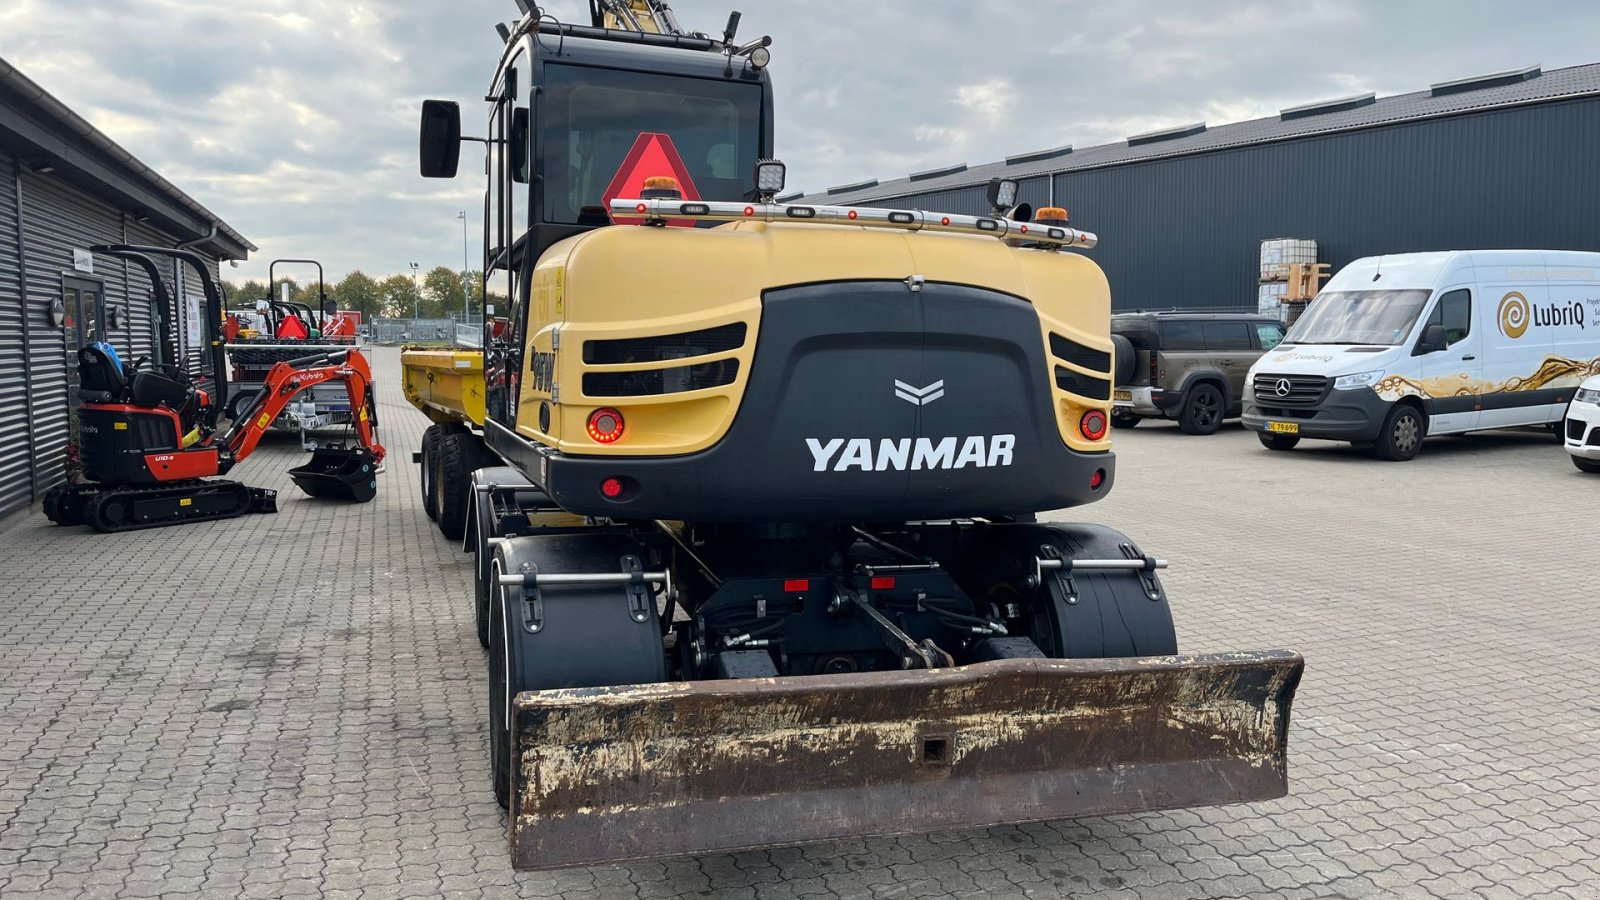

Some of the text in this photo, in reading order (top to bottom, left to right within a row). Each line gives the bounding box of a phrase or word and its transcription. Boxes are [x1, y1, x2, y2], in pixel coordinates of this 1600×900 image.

[1533, 300, 1584, 330] LubriQ
[300, 372, 323, 380] Kubota
[805, 434, 1016, 471] YANMAR
